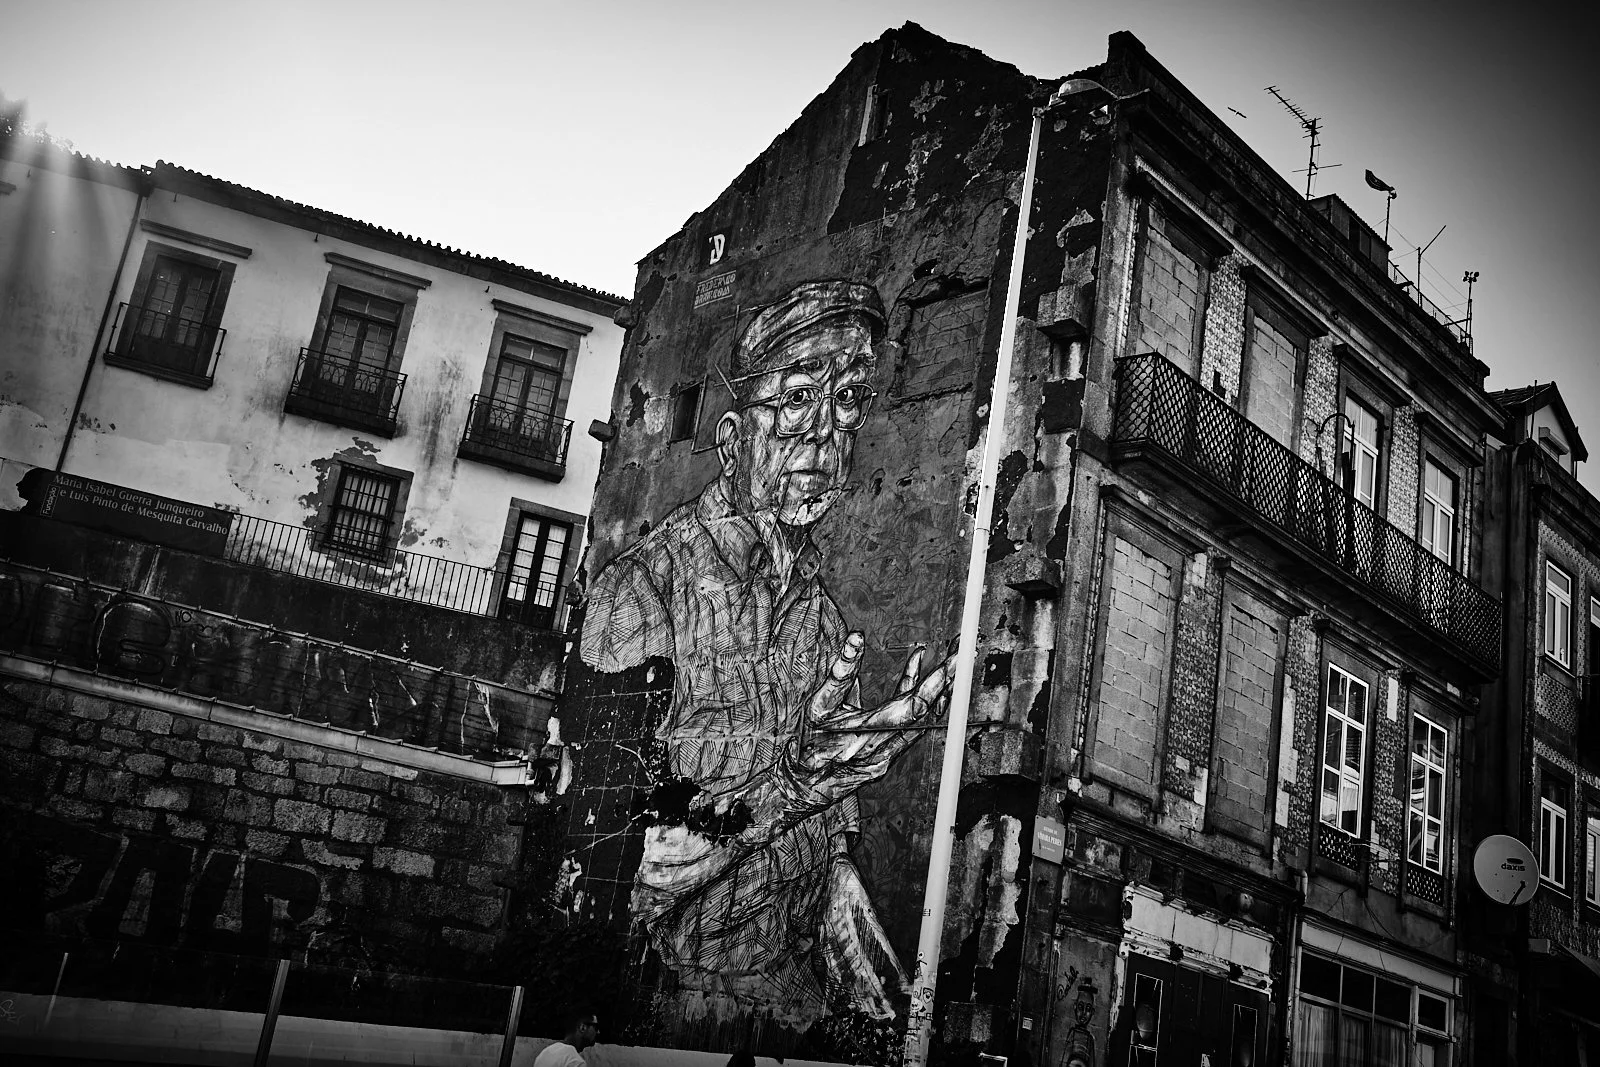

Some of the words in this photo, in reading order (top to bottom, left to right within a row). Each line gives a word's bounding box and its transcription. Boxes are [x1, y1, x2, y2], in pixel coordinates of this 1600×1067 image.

[696, 273, 736, 295] FREDERICO
[53, 474, 82, 489] Maria
[85, 482, 116, 497] Isabel
[119, 490, 152, 506] Guerra
[155, 500, 204, 518] Junqueiro
[60, 489, 67, 497] e
[92, 495, 119, 510] Pinto
[121, 502, 134, 513] de
[136, 506, 182, 525] Mesquita
[185, 517, 228, 535] Carvalho
[1501, 863, 1526, 872] daxis
